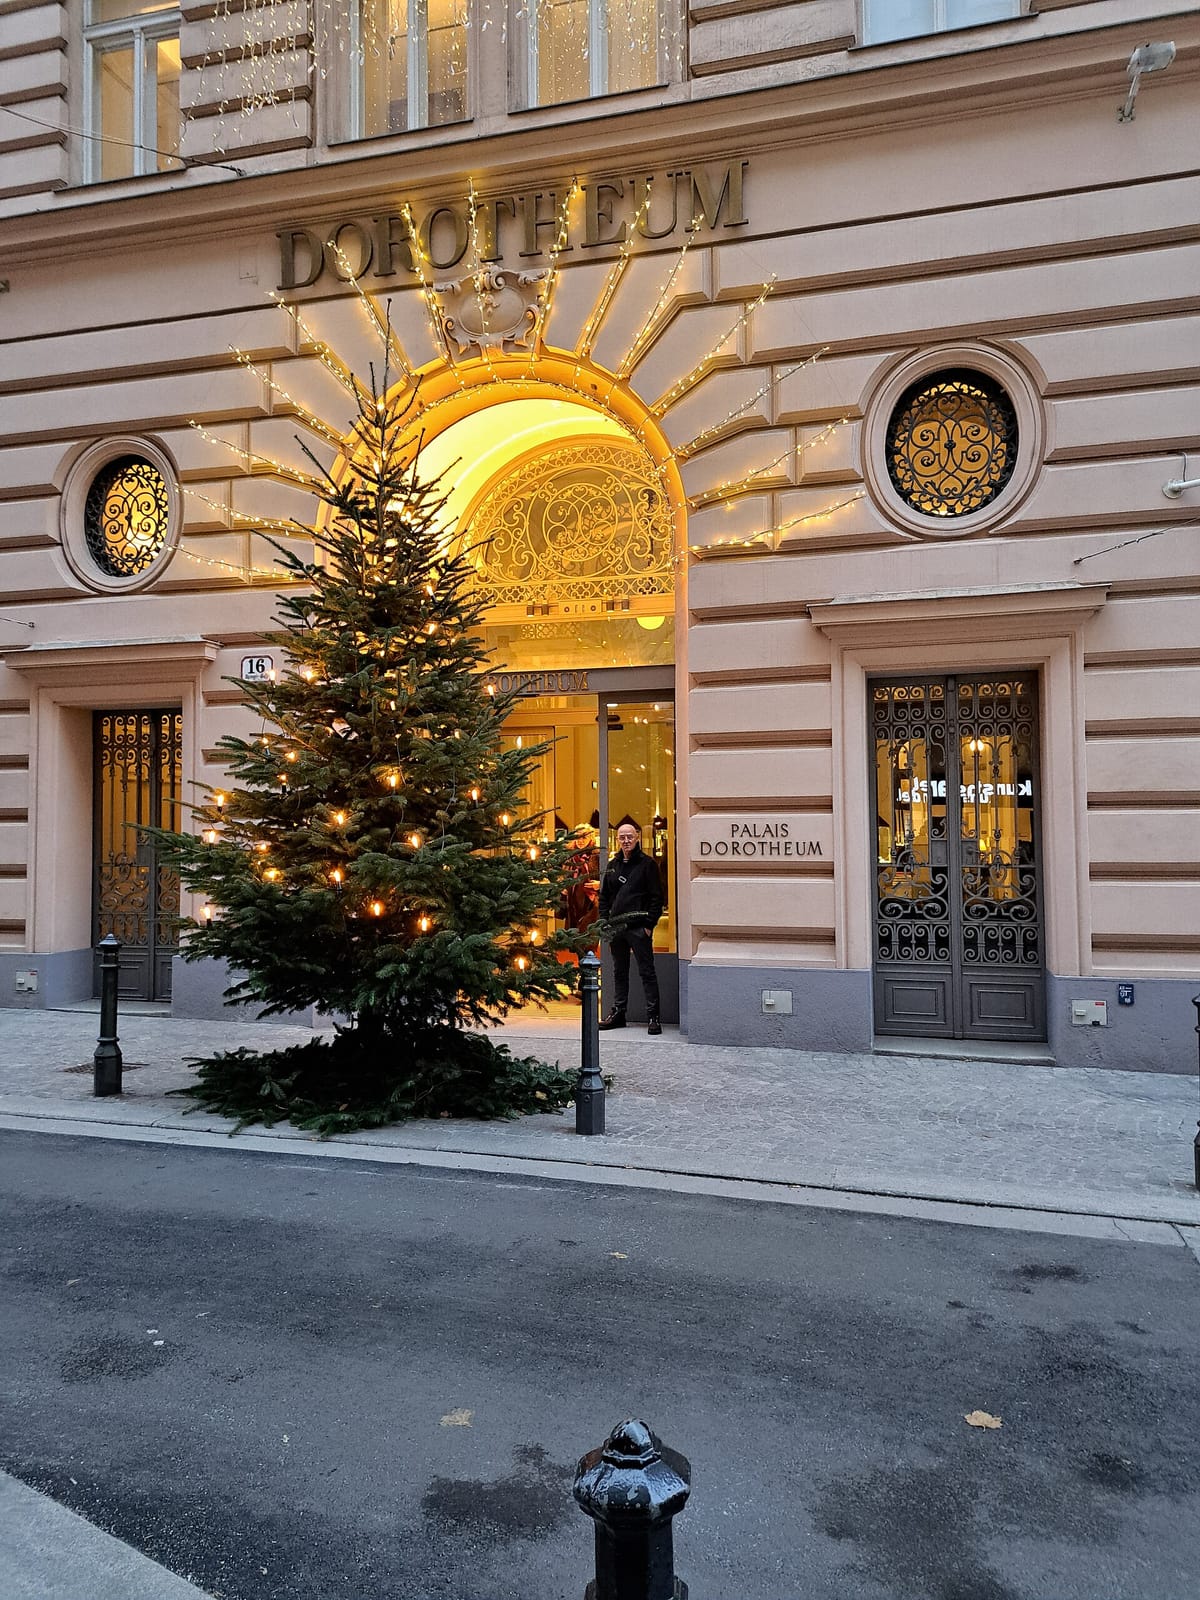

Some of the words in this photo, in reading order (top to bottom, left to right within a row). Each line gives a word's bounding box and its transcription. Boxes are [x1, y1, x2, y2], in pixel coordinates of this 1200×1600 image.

[275, 159, 749, 291] DOROTHEUM
[247, 658, 266, 674] 16
[482, 671, 589, 695] ROTHEUM
[731, 823, 789, 838] PALAIS
[700, 841, 823, 856] DOROTHEUM
